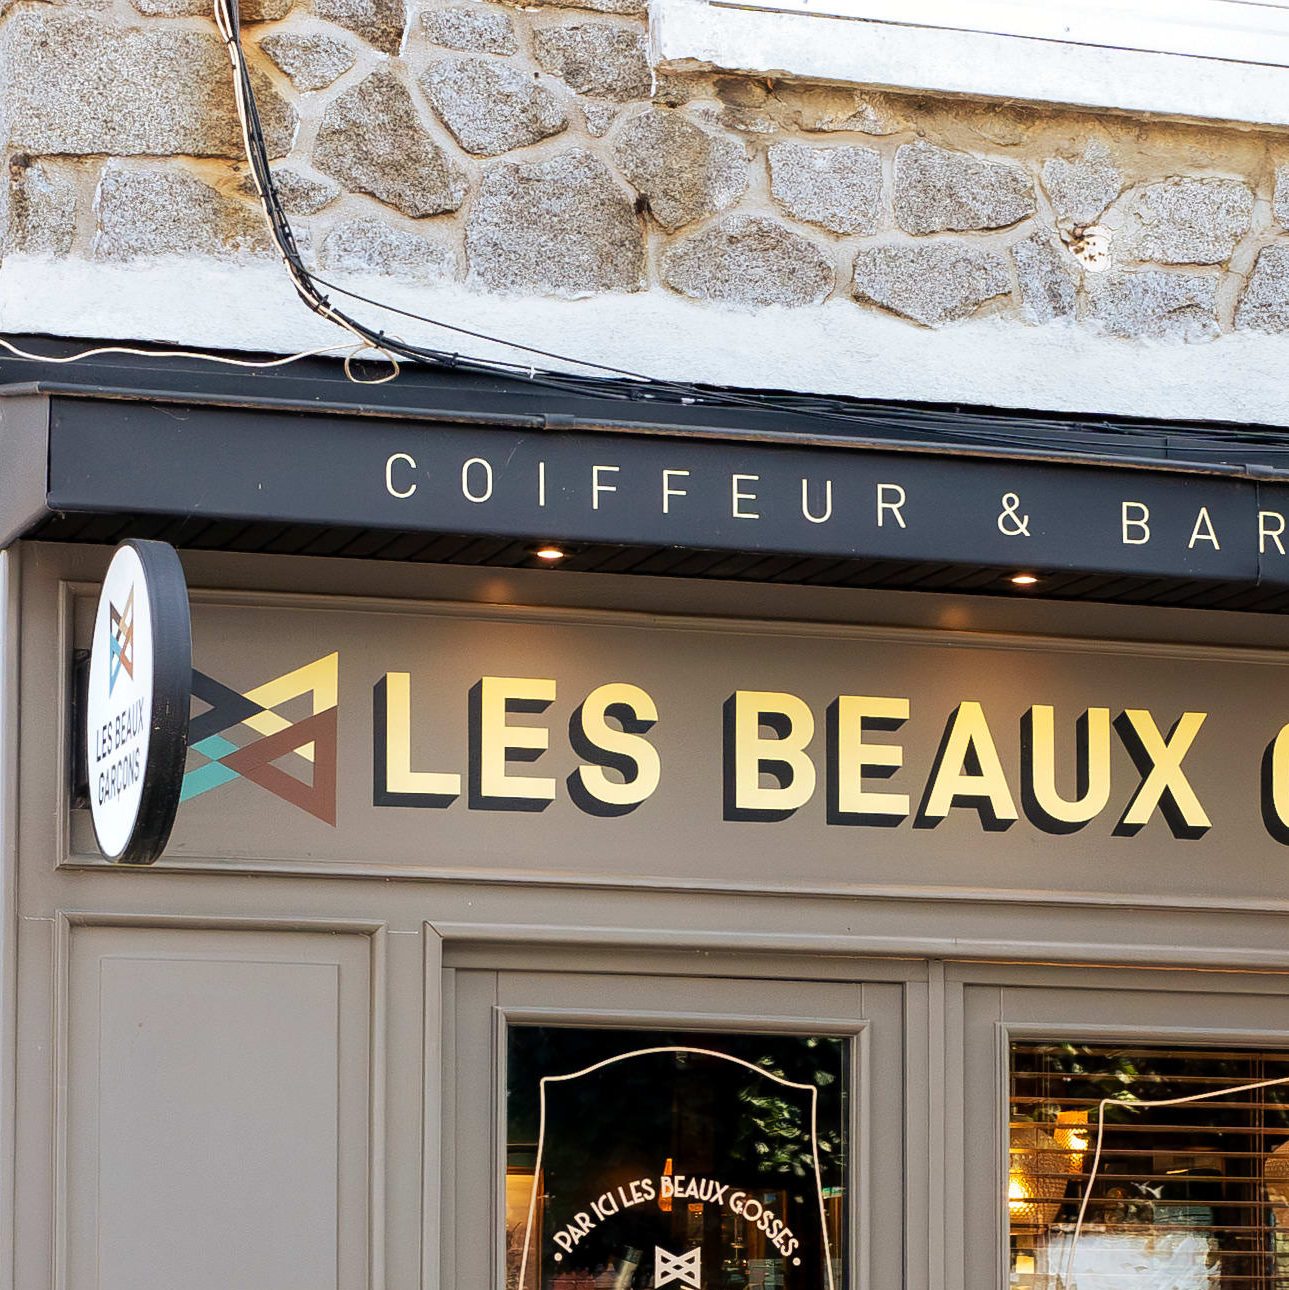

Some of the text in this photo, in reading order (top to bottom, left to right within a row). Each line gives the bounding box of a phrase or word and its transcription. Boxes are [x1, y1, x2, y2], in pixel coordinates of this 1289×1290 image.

[384, 452, 908, 530] COIFFEUR
[996, 492, 1032, 538] &
[96, 696, 144, 763] LES BEAUX
[373, 671, 661, 818] LES
[722, 689, 1213, 841] BEAUX
[98, 746, 140, 807] GARÇONS
[552, 1175, 799, 1257] PAR ICI LES BEAUX GOSSES
